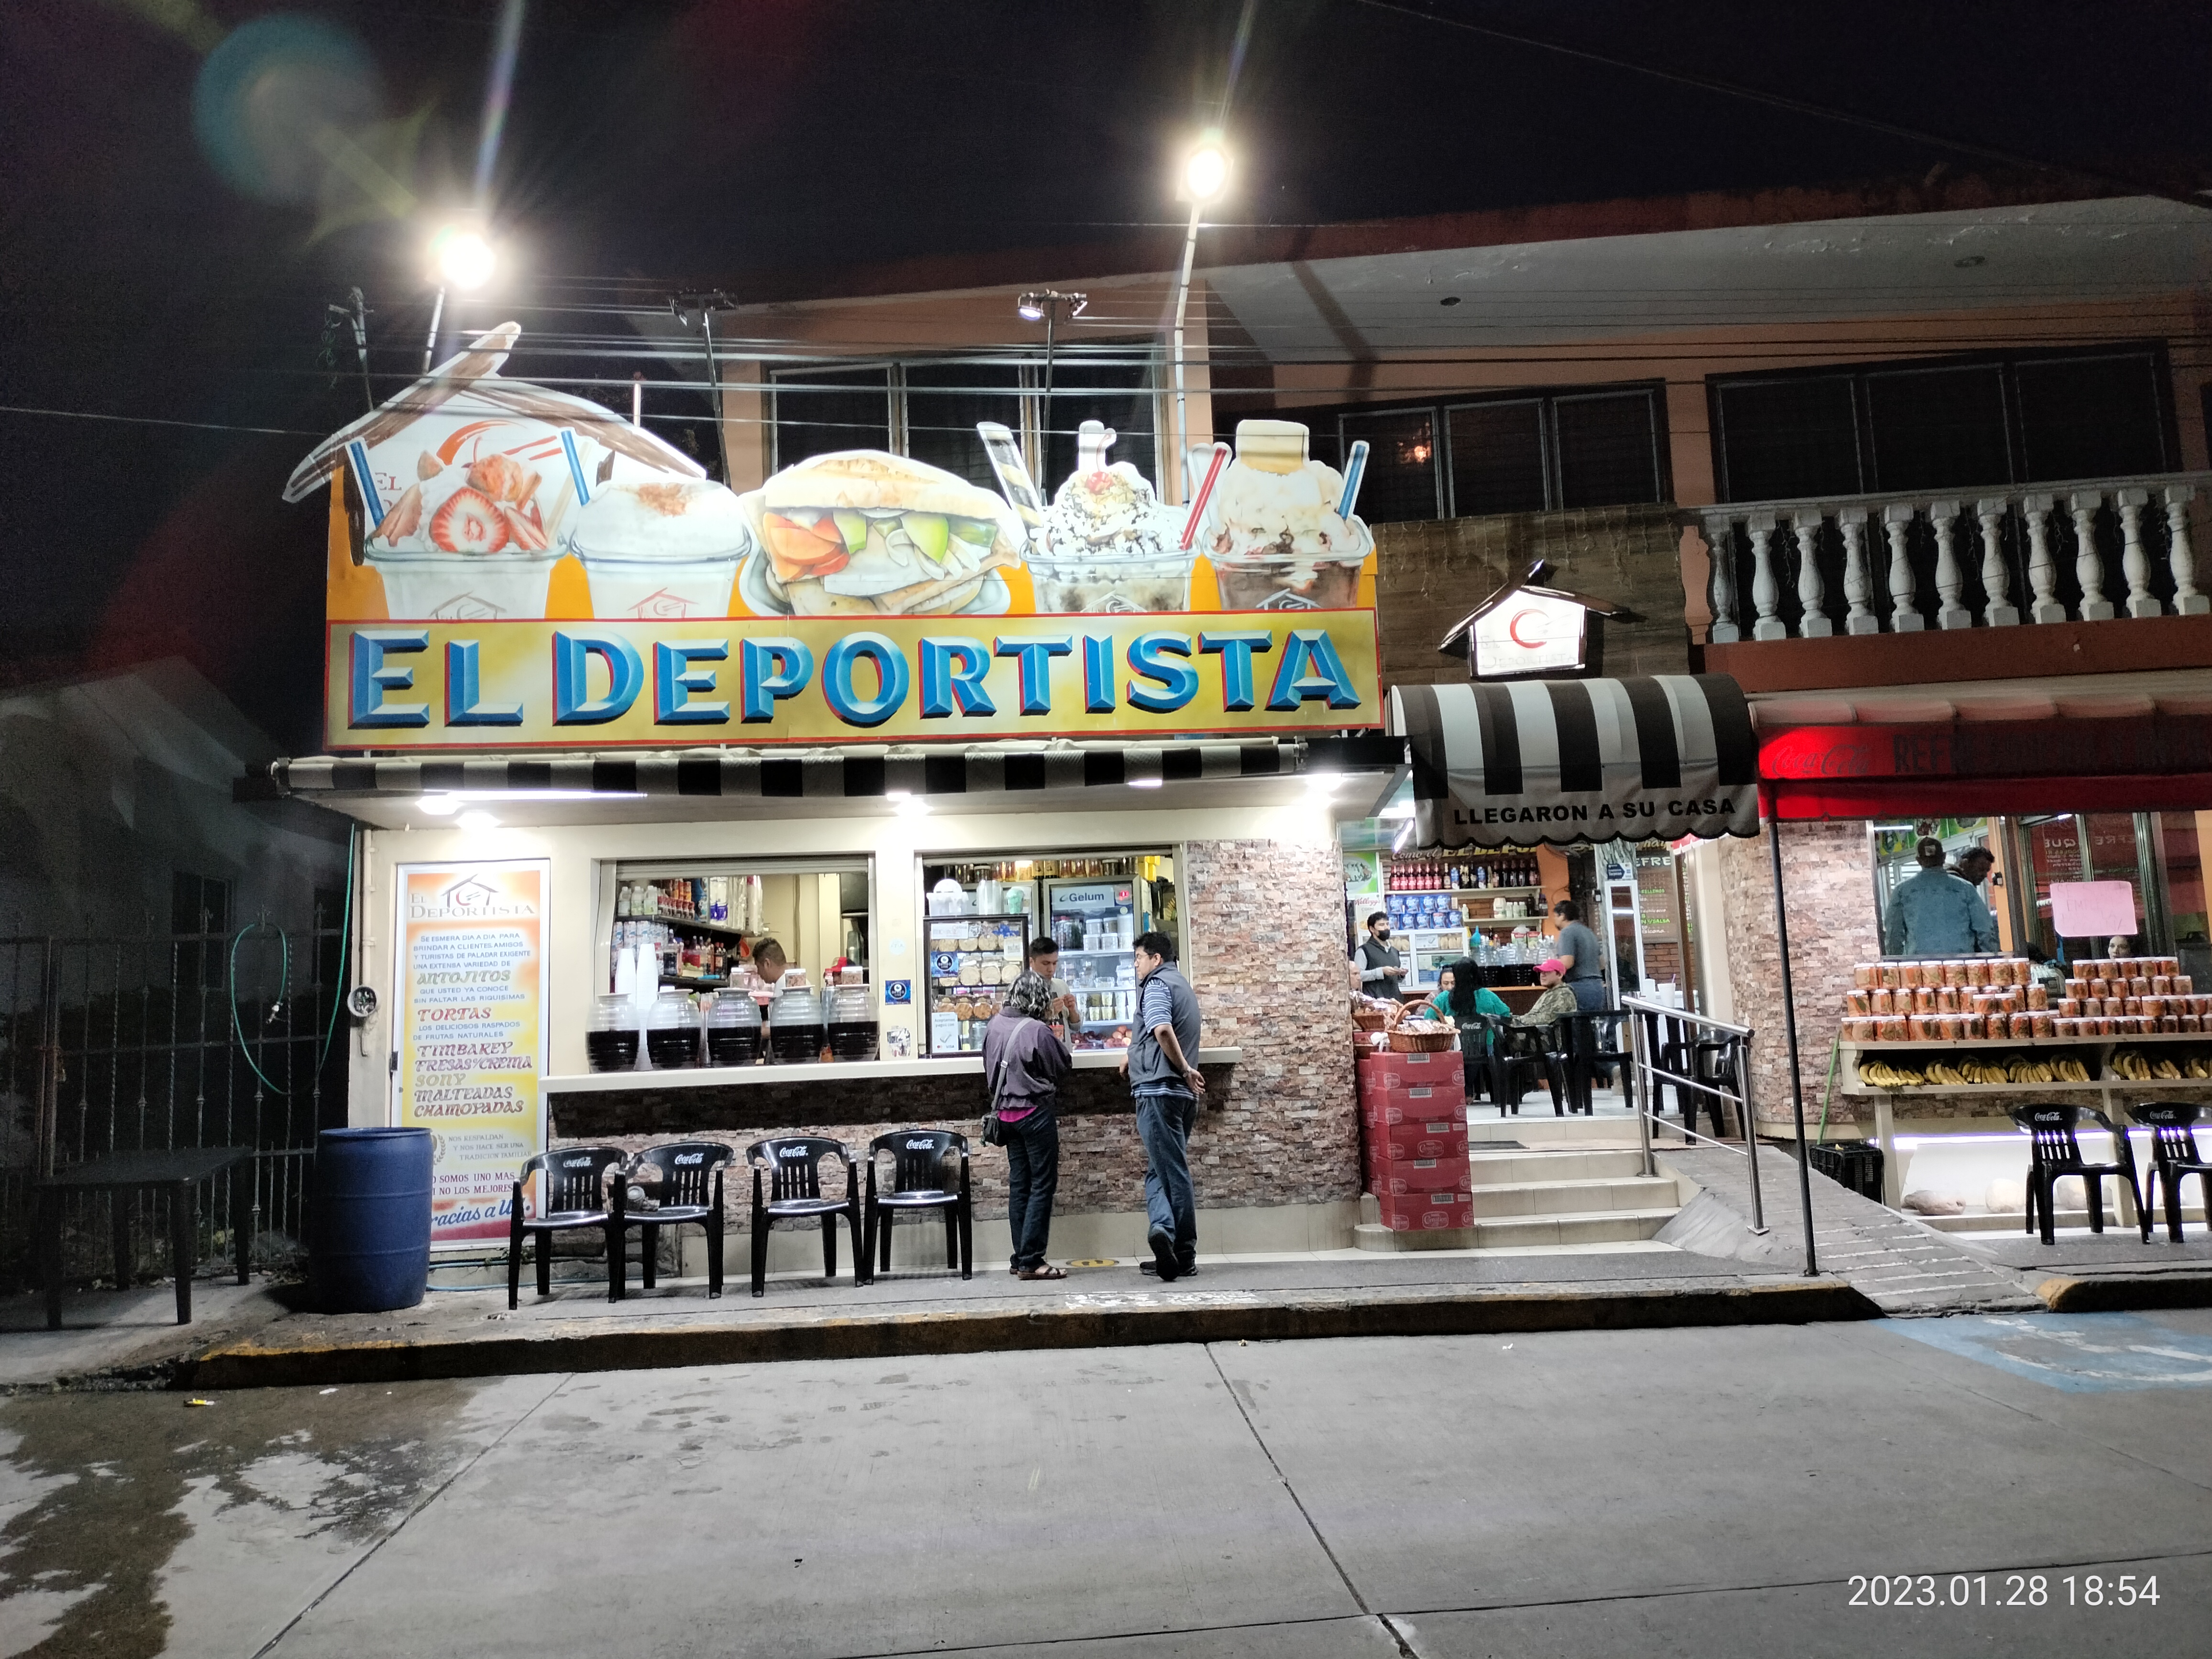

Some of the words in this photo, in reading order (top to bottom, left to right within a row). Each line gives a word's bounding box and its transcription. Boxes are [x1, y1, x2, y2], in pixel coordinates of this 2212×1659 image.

[348, 630, 523, 730] EL
[552, 629, 1361, 728] DEPORTISTA
[1454, 805, 1588, 825] LLEGARON
[1598, 804, 1615, 820] A
[1622, 801, 1656, 819] SU
[1668, 798, 1736, 816] CASA
[411, 893, 427, 904] EL
[1069, 892, 1104, 902] Gelum
[410, 905, 535, 918] DEPORTISTA
[416, 970, 511, 985] ANTOJITOS
[417, 1006, 492, 1022] TORTAS
[417, 1041, 513, 1058] TIMBAREY
[415, 1073, 466, 1087] SONY
[414, 1086, 513, 1103] MALTEADAS
[414, 1100, 525, 1118] CHAMOYADAS
[439, 1173, 469, 1183] SOMOS
[474, 1172, 491, 1182] UNO
[495, 1172, 515, 1181] MAS
[439, 1187, 451, 1195] NO
[454, 1186, 470, 1194] LOS
[474, 1184, 513, 1194] MEJORES
[431, 1206, 481, 1226] racias
[485, 1206, 496, 1218] a
